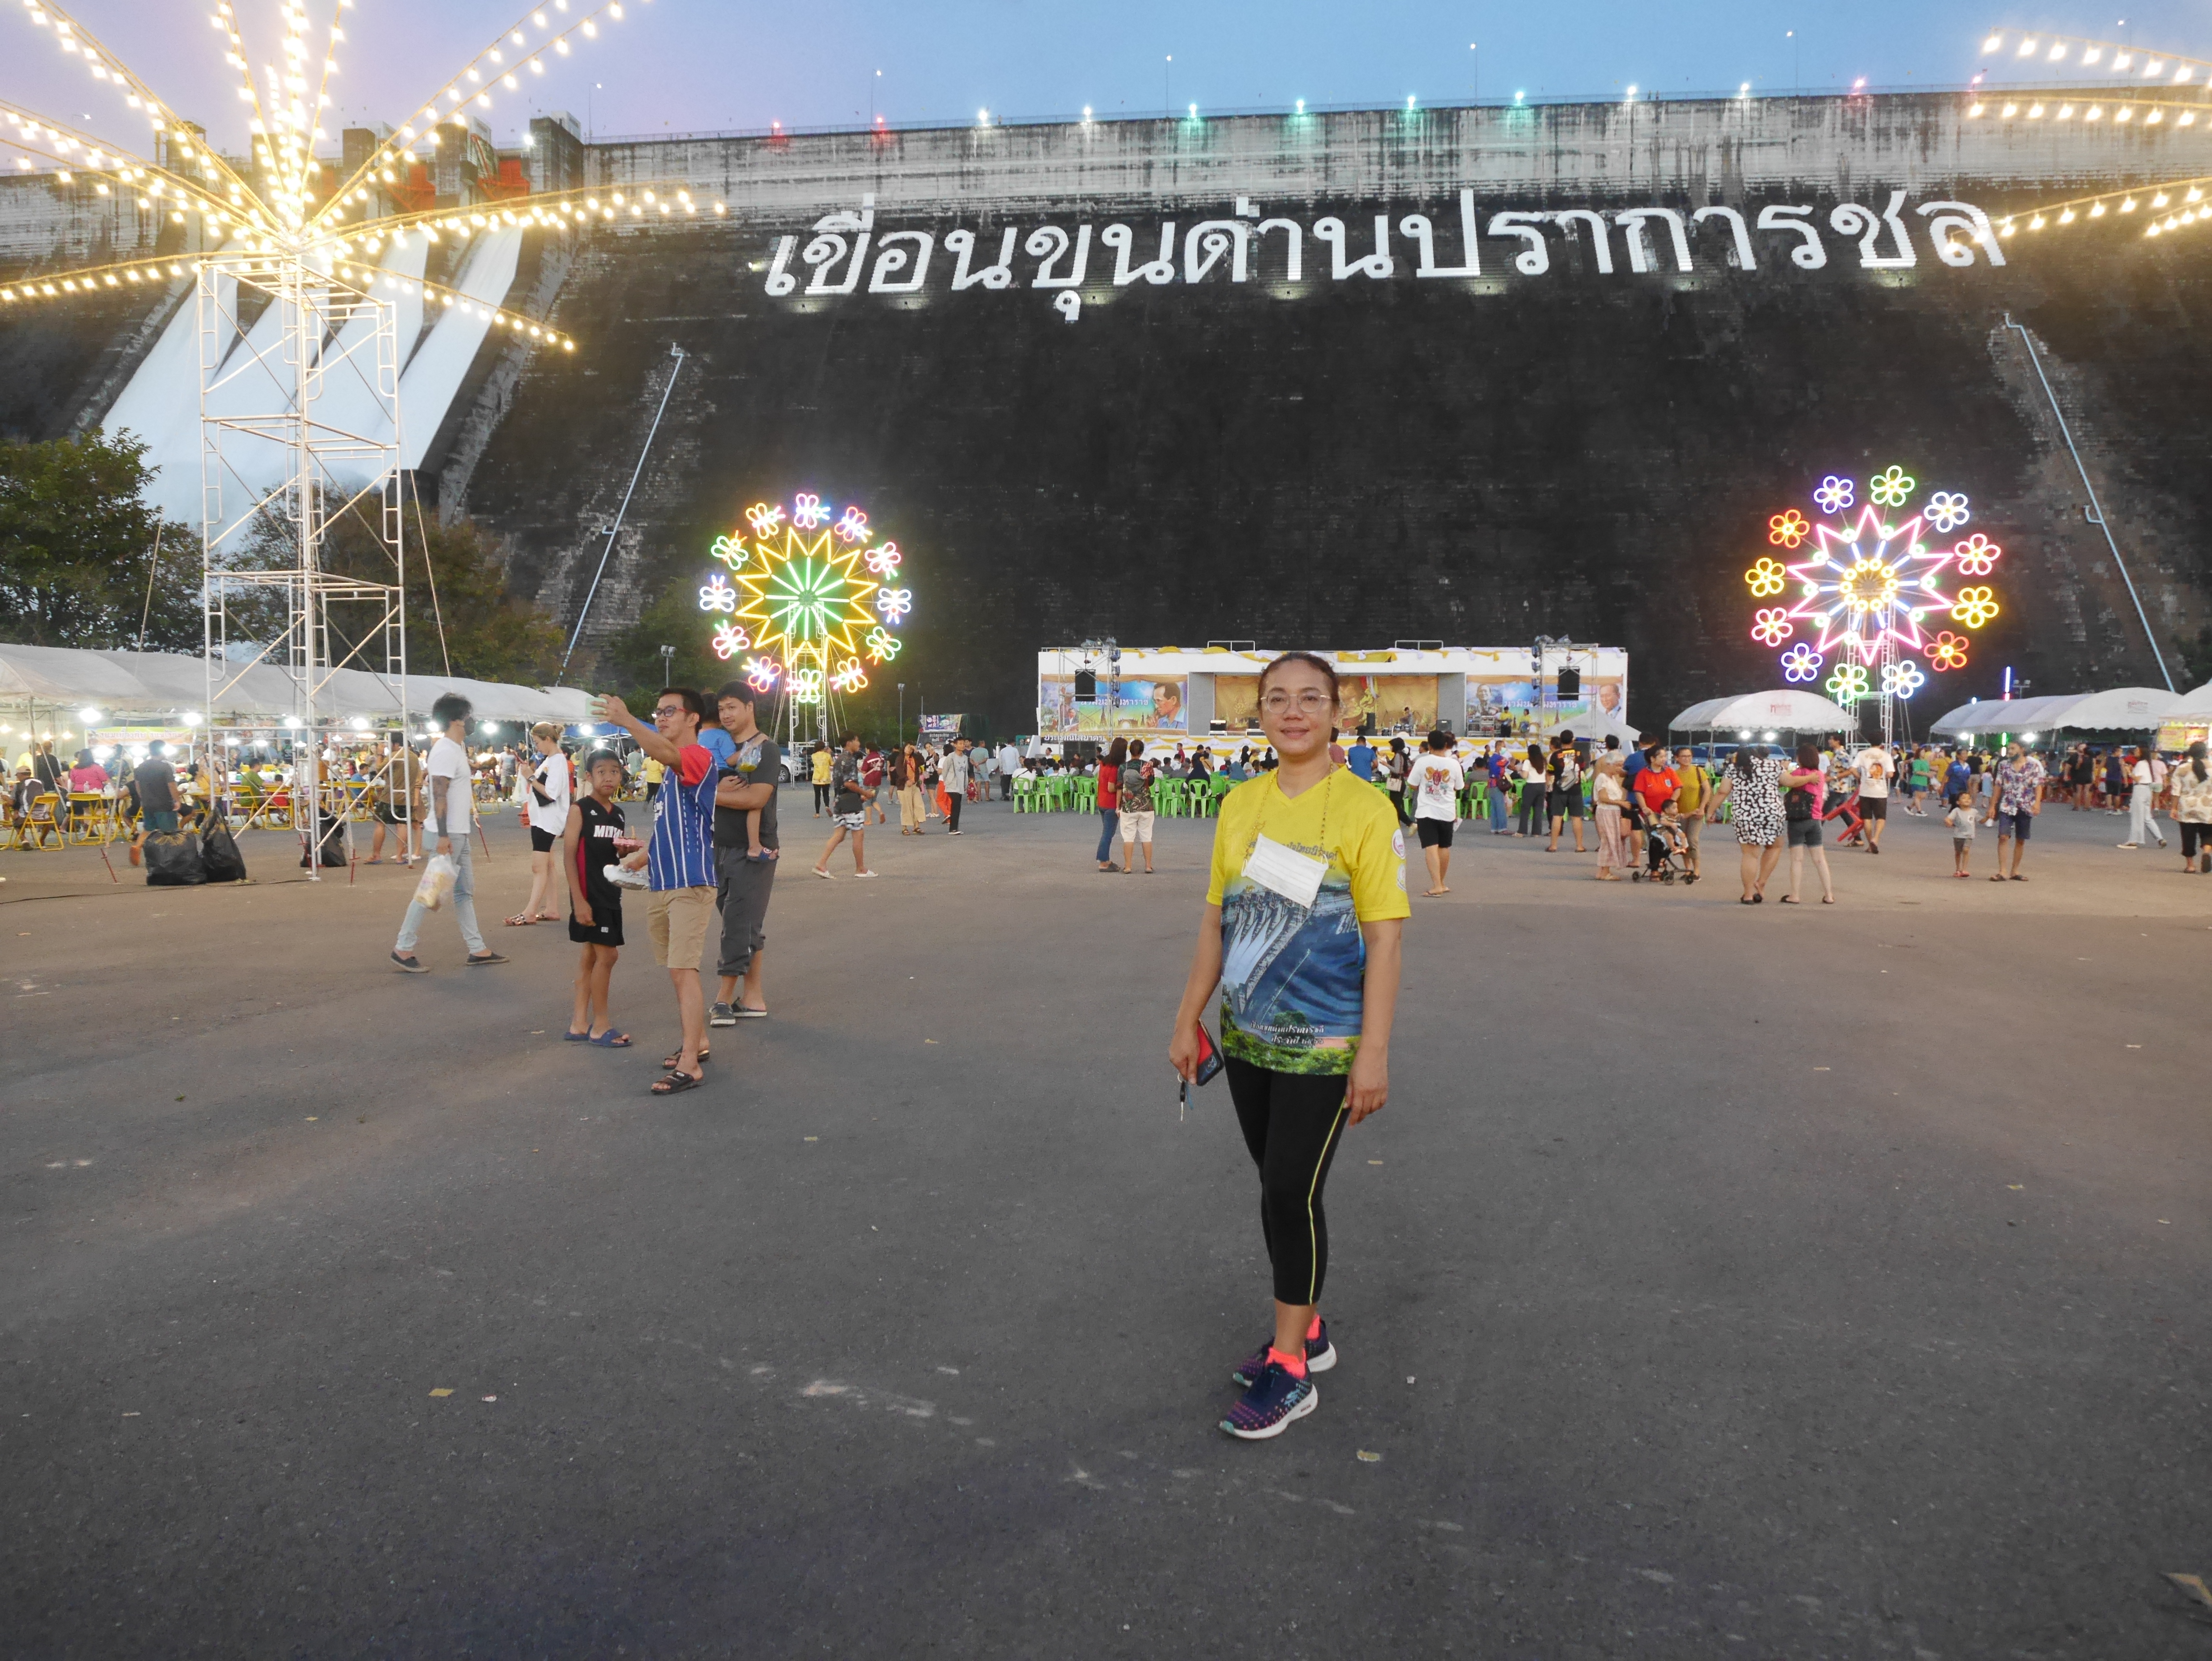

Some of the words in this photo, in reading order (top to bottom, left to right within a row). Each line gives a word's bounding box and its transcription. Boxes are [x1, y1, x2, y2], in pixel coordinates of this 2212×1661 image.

[764, 189, 2007, 321] เขื่อนขุนด่านปราการชล
